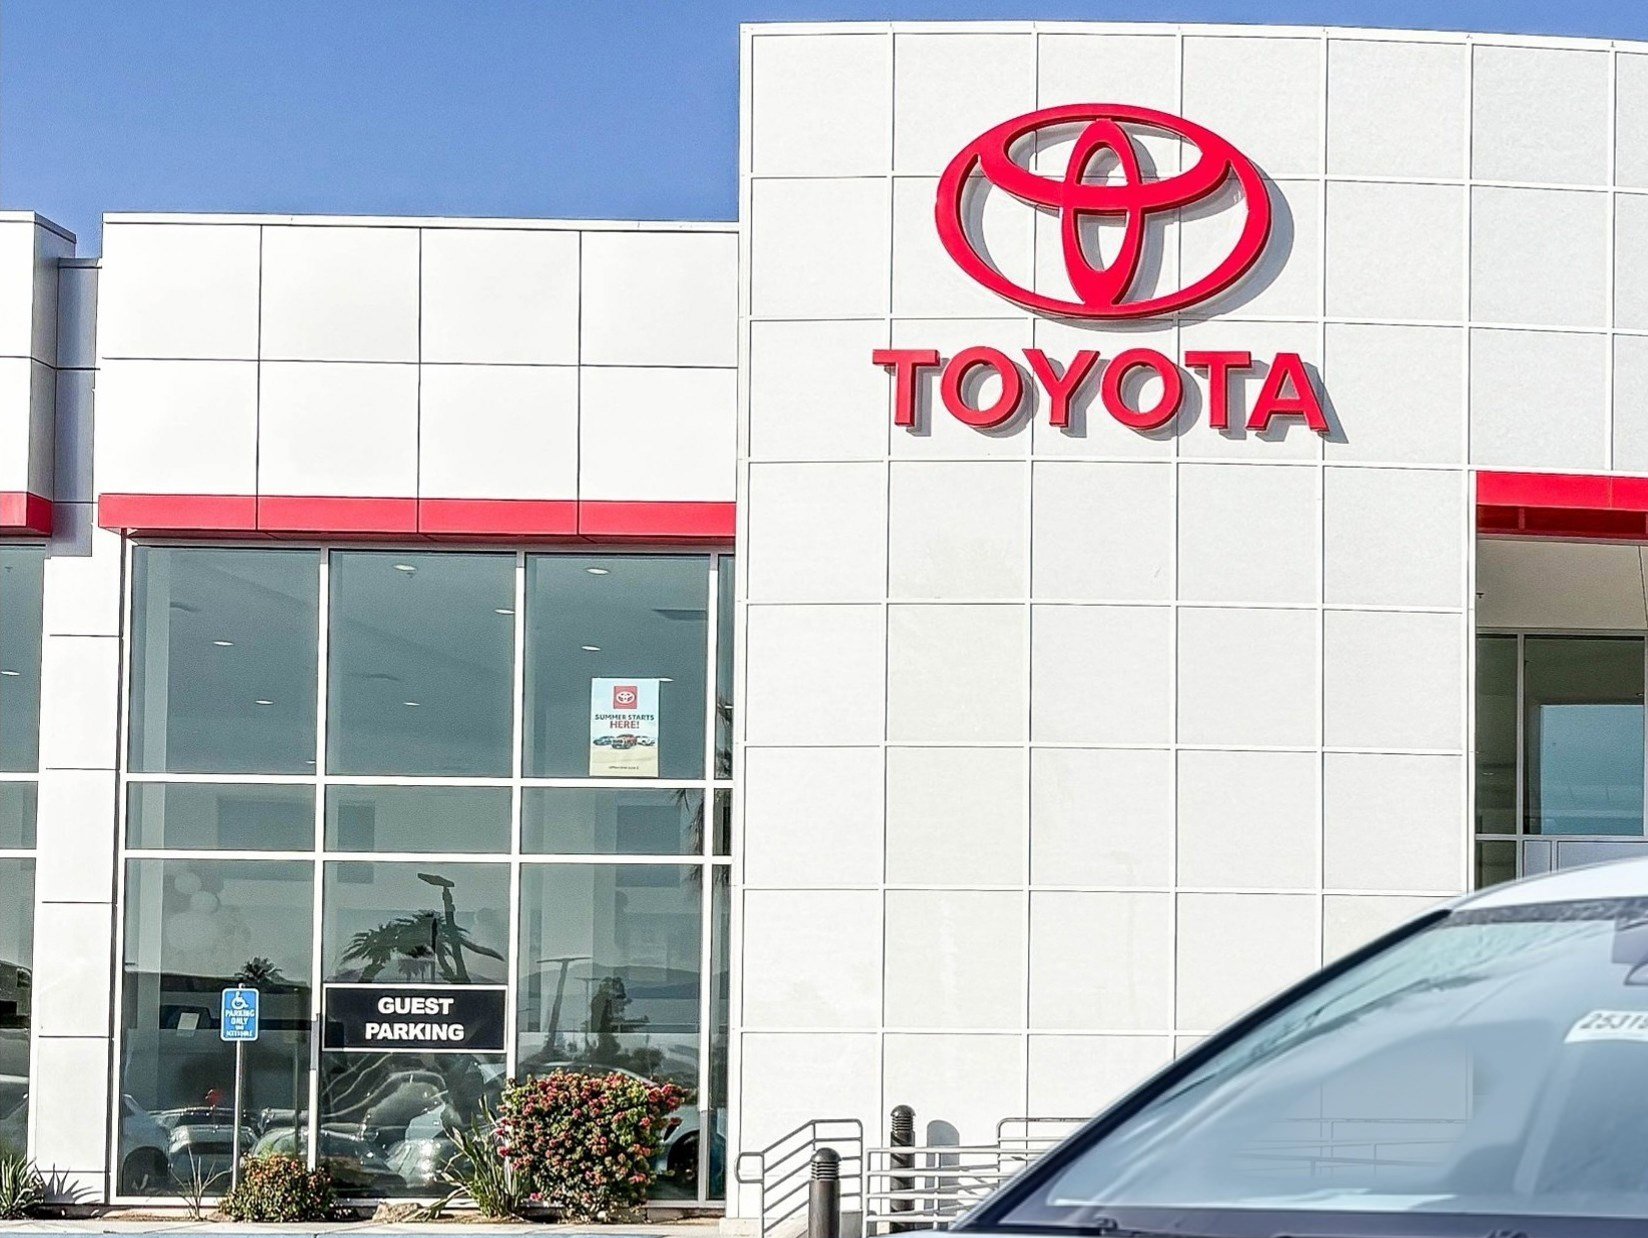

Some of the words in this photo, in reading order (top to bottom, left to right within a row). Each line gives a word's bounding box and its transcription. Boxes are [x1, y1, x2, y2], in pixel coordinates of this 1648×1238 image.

[872, 345, 1330, 433] TOYOTA
[609, 720, 640, 729] HERE!
[225, 1009, 255, 1017] PARKING
[377, 997, 455, 1015] GUEST
[365, 1022, 465, 1041] PARKING
